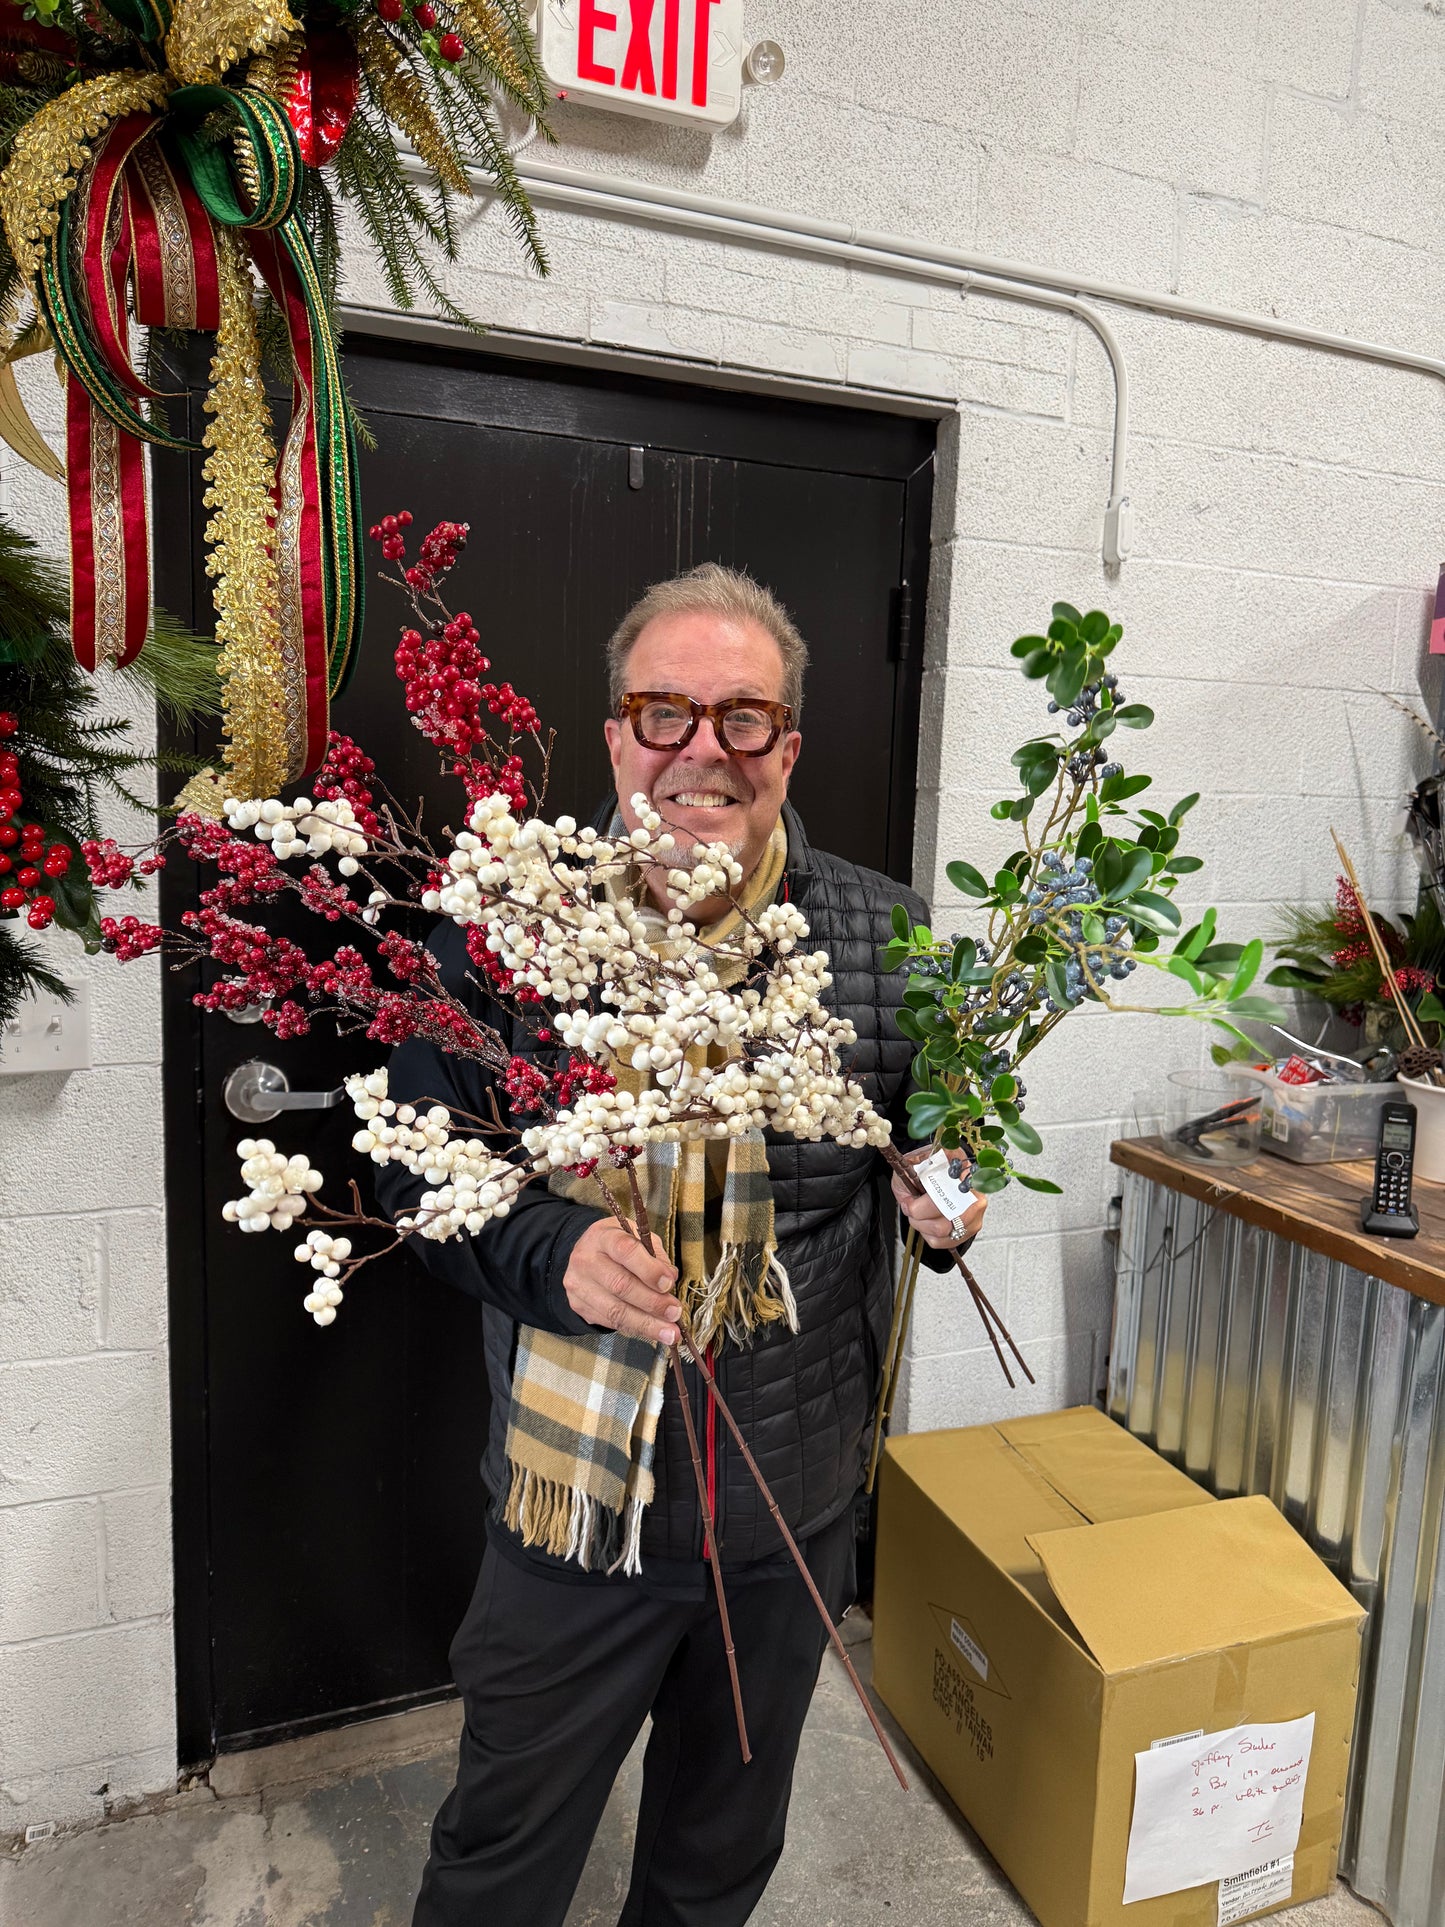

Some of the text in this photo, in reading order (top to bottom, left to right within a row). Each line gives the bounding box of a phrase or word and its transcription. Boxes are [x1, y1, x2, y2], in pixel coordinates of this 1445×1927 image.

[577, 0, 720, 108] EXIT
[933, 1674, 953, 1708] MADE
[965, 1712, 993, 1759] TAIWAN
[934, 1658, 950, 1688] LOS
[953, 1685, 992, 1741] ANGELES
[1223, 1863, 1268, 1887] Smithfield
[1270, 1858, 1280, 1870] #1
